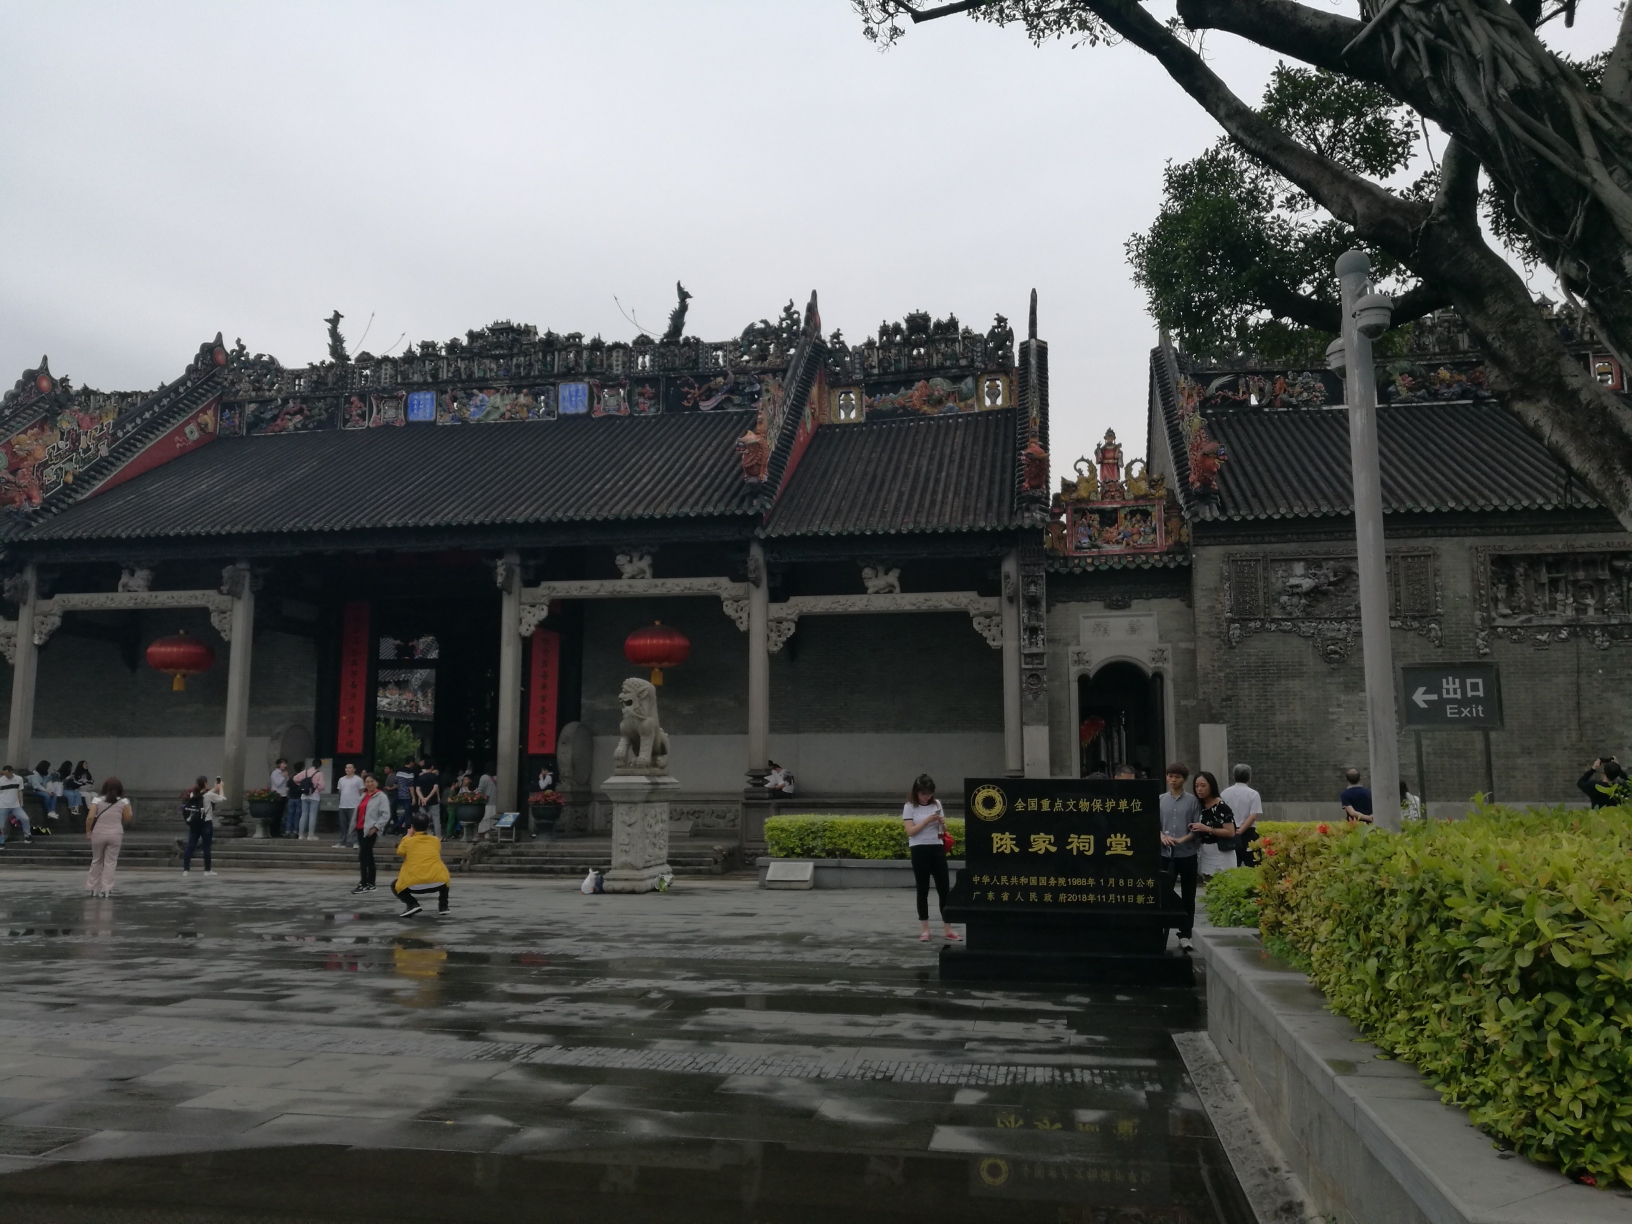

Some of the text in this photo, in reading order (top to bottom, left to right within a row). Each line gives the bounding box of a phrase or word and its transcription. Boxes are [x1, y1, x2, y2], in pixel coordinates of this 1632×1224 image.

[1442, 676, 1484, 699] 出口
[1446, 704, 1484, 718] Exit
[1014, 797, 1143, 813] 全国重点文物保护单位
[991, 831, 1134, 856] 陈家祠堂
